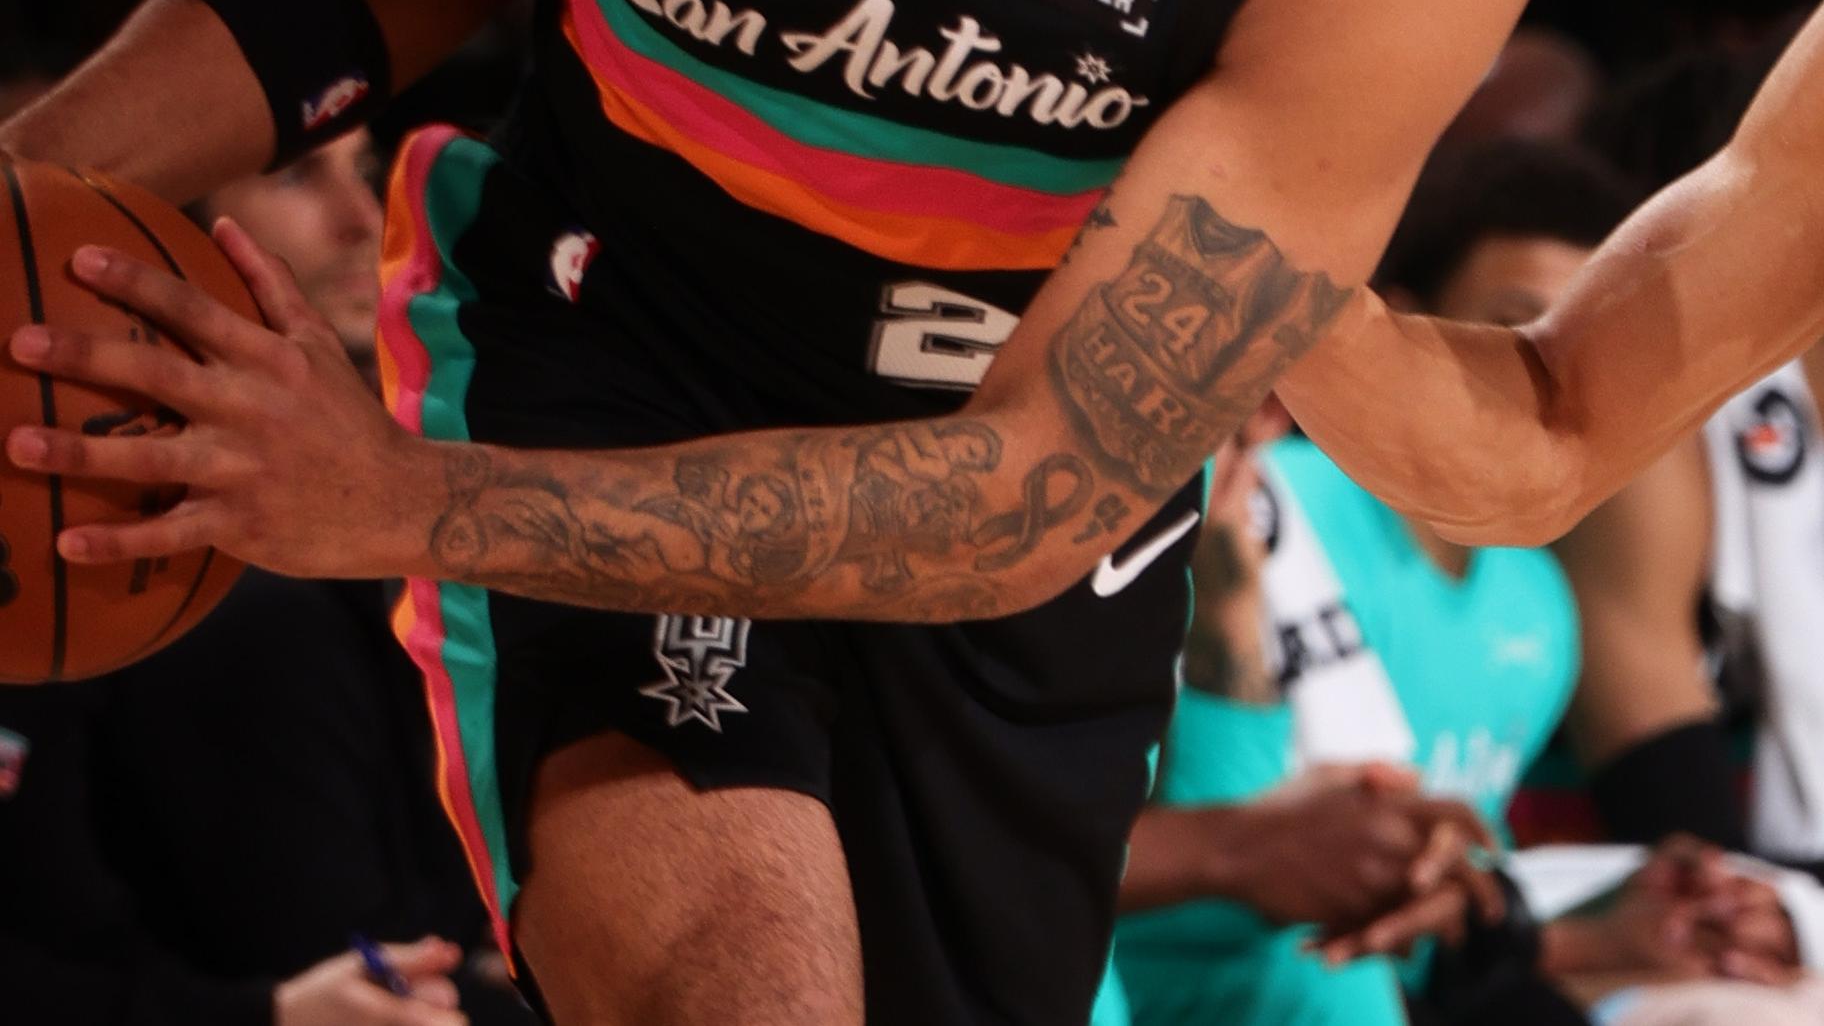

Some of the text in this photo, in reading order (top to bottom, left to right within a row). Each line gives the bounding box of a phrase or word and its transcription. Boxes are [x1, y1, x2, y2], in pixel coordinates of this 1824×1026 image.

[866, 279, 1021, 392] 2
[1122, 271, 1210, 354] 24
[1082, 328, 1196, 437] HAR
